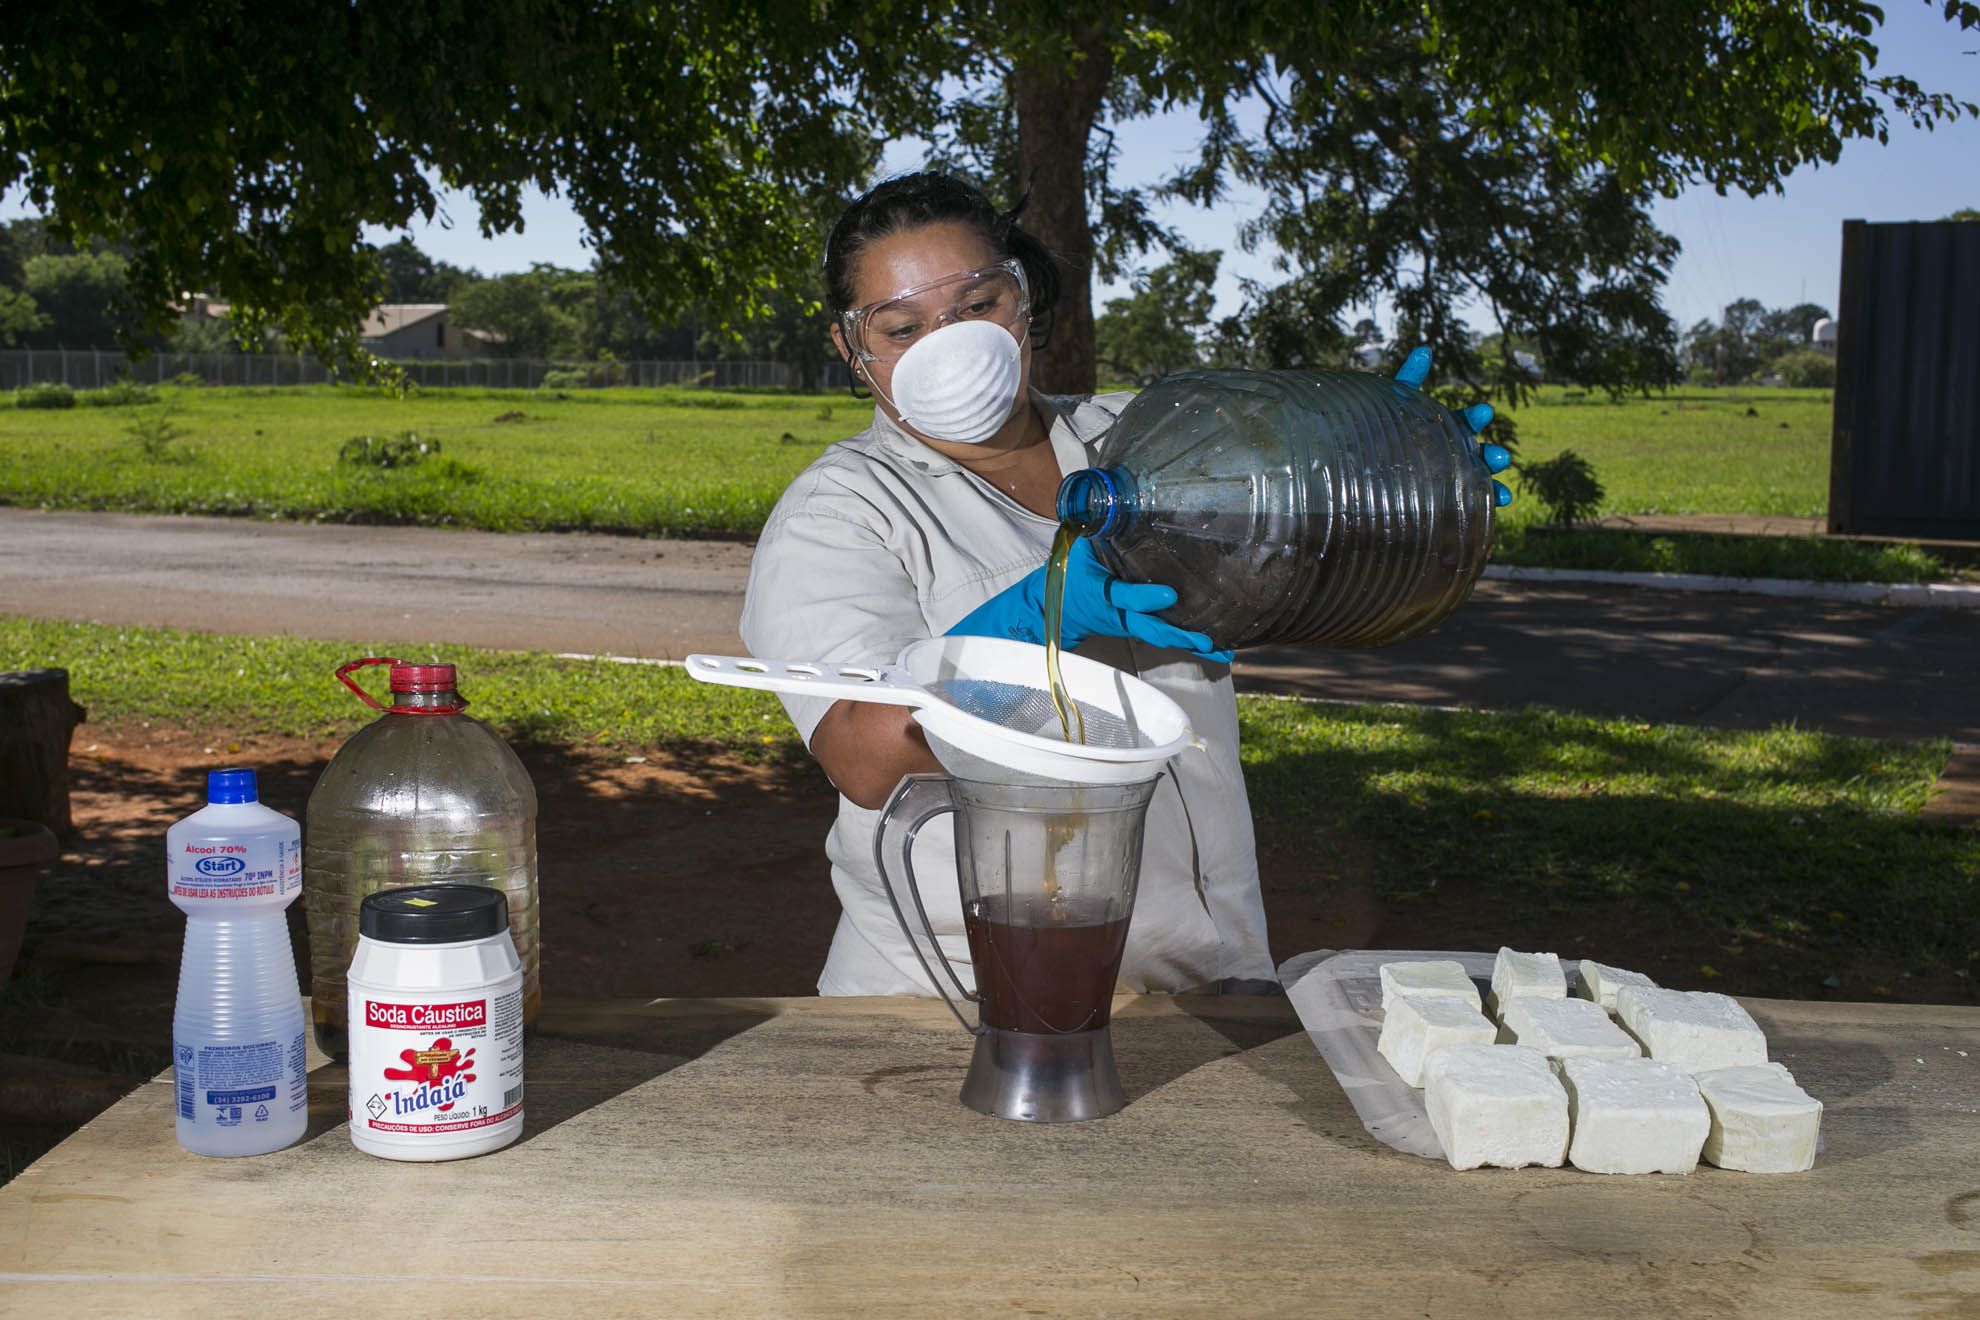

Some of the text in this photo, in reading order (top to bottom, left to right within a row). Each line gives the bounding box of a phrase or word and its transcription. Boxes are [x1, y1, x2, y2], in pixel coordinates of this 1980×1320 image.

[186, 843, 247, 854] Álcool 70%
[203, 860, 236, 872] Start
[249, 886, 256, 896] DO
[369, 1003, 483, 1024] Soda Cáustica
[393, 1074, 465, 1115] Indaiá
[472, 1106, 476, 1116] 1
[478, 1105, 487, 1117] kg
[372, 1121, 408, 1132] PRECAUÇÕES
[435, 1123, 469, 1131] CONSERVE
[470, 1119, 486, 1128] FORA
